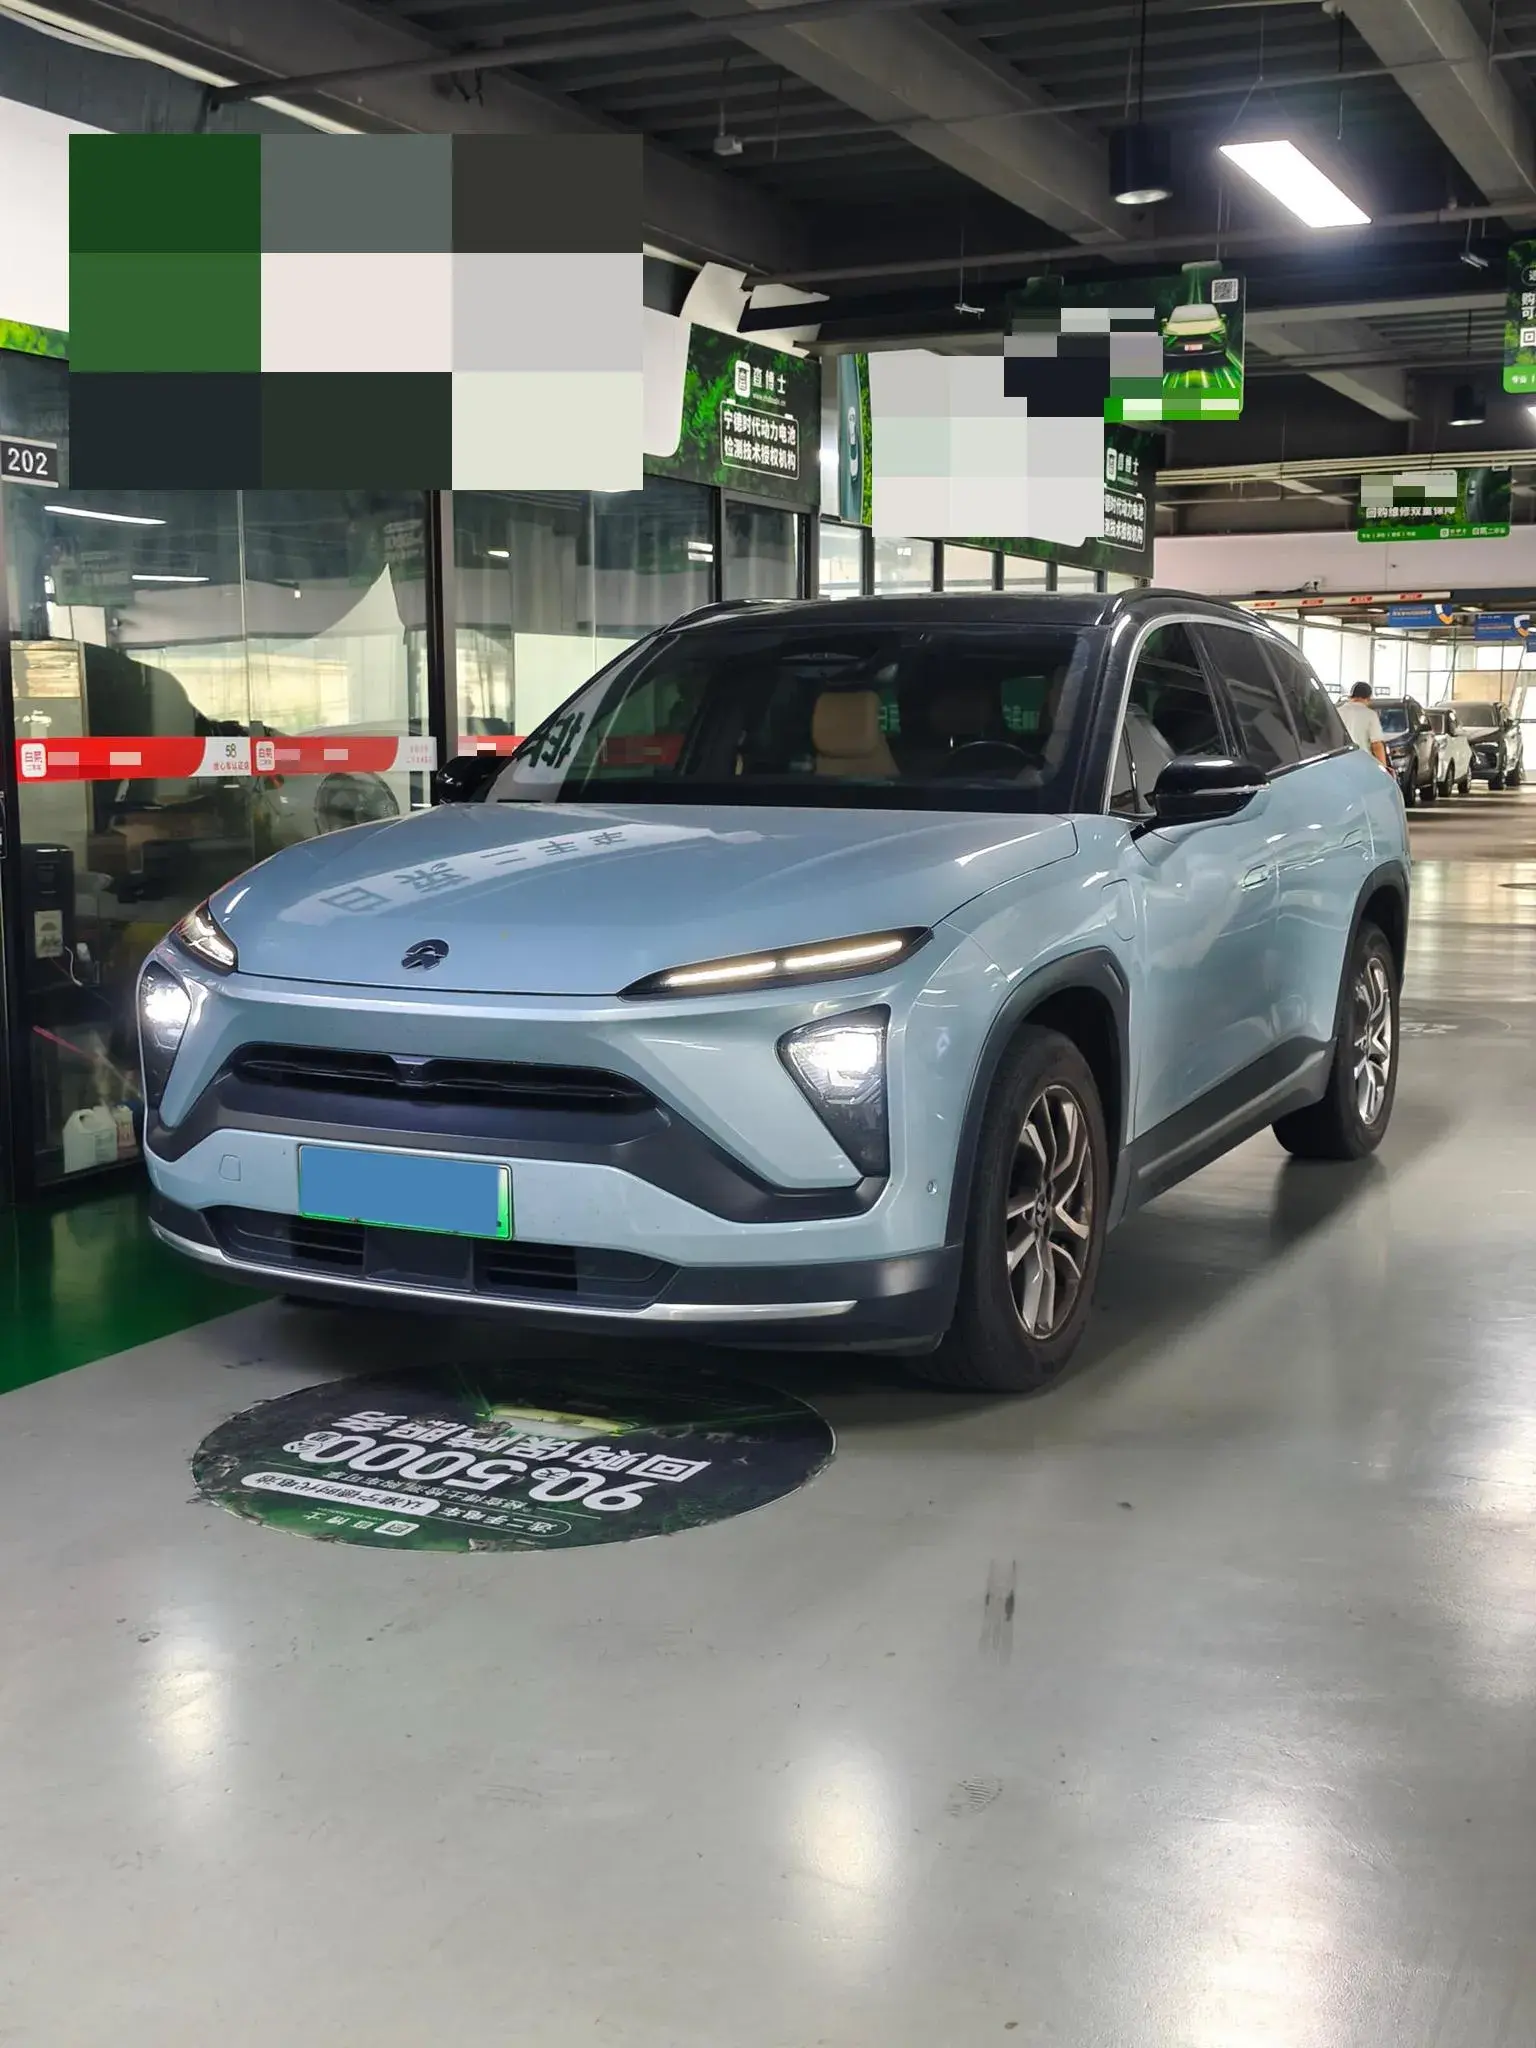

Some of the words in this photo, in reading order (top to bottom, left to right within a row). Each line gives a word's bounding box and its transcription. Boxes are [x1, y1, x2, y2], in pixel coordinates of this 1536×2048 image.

[752, 367, 787, 395] 查博士
[723, 410, 797, 446] 宁德时代动力电池
[8, 447, 48, 476] 202
[723, 435, 797, 471] 检测技术授权机构
[225, 743, 237, 758] 58
[329, 1410, 712, 1482] 回购保障服务
